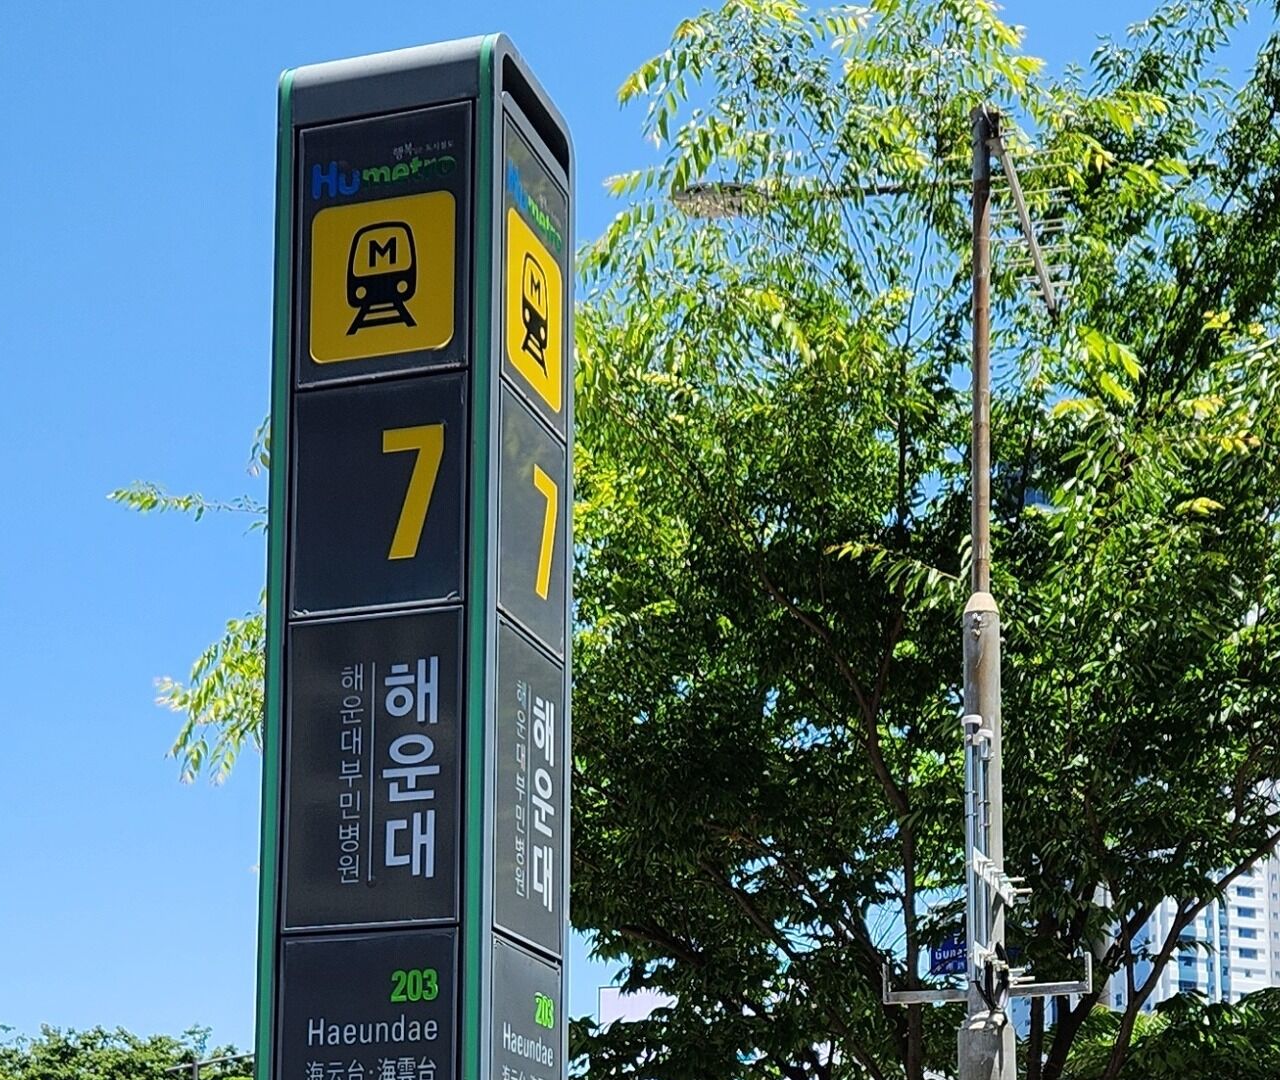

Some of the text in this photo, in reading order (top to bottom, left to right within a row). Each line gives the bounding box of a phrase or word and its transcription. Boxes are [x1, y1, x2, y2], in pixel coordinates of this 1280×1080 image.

[382, 424, 444, 560] 7
[533, 463, 558, 599] 7
[337, 663, 364, 884] 해운대부민병원
[382, 655, 440, 878] 해운대
[532, 696, 555, 912] 해운대
[307, 1014, 438, 1046] Haeundae
[391, 968, 439, 1002] 203
[503, 1022, 554, 1067] Haeundae
[533, 992, 555, 1029] 203
